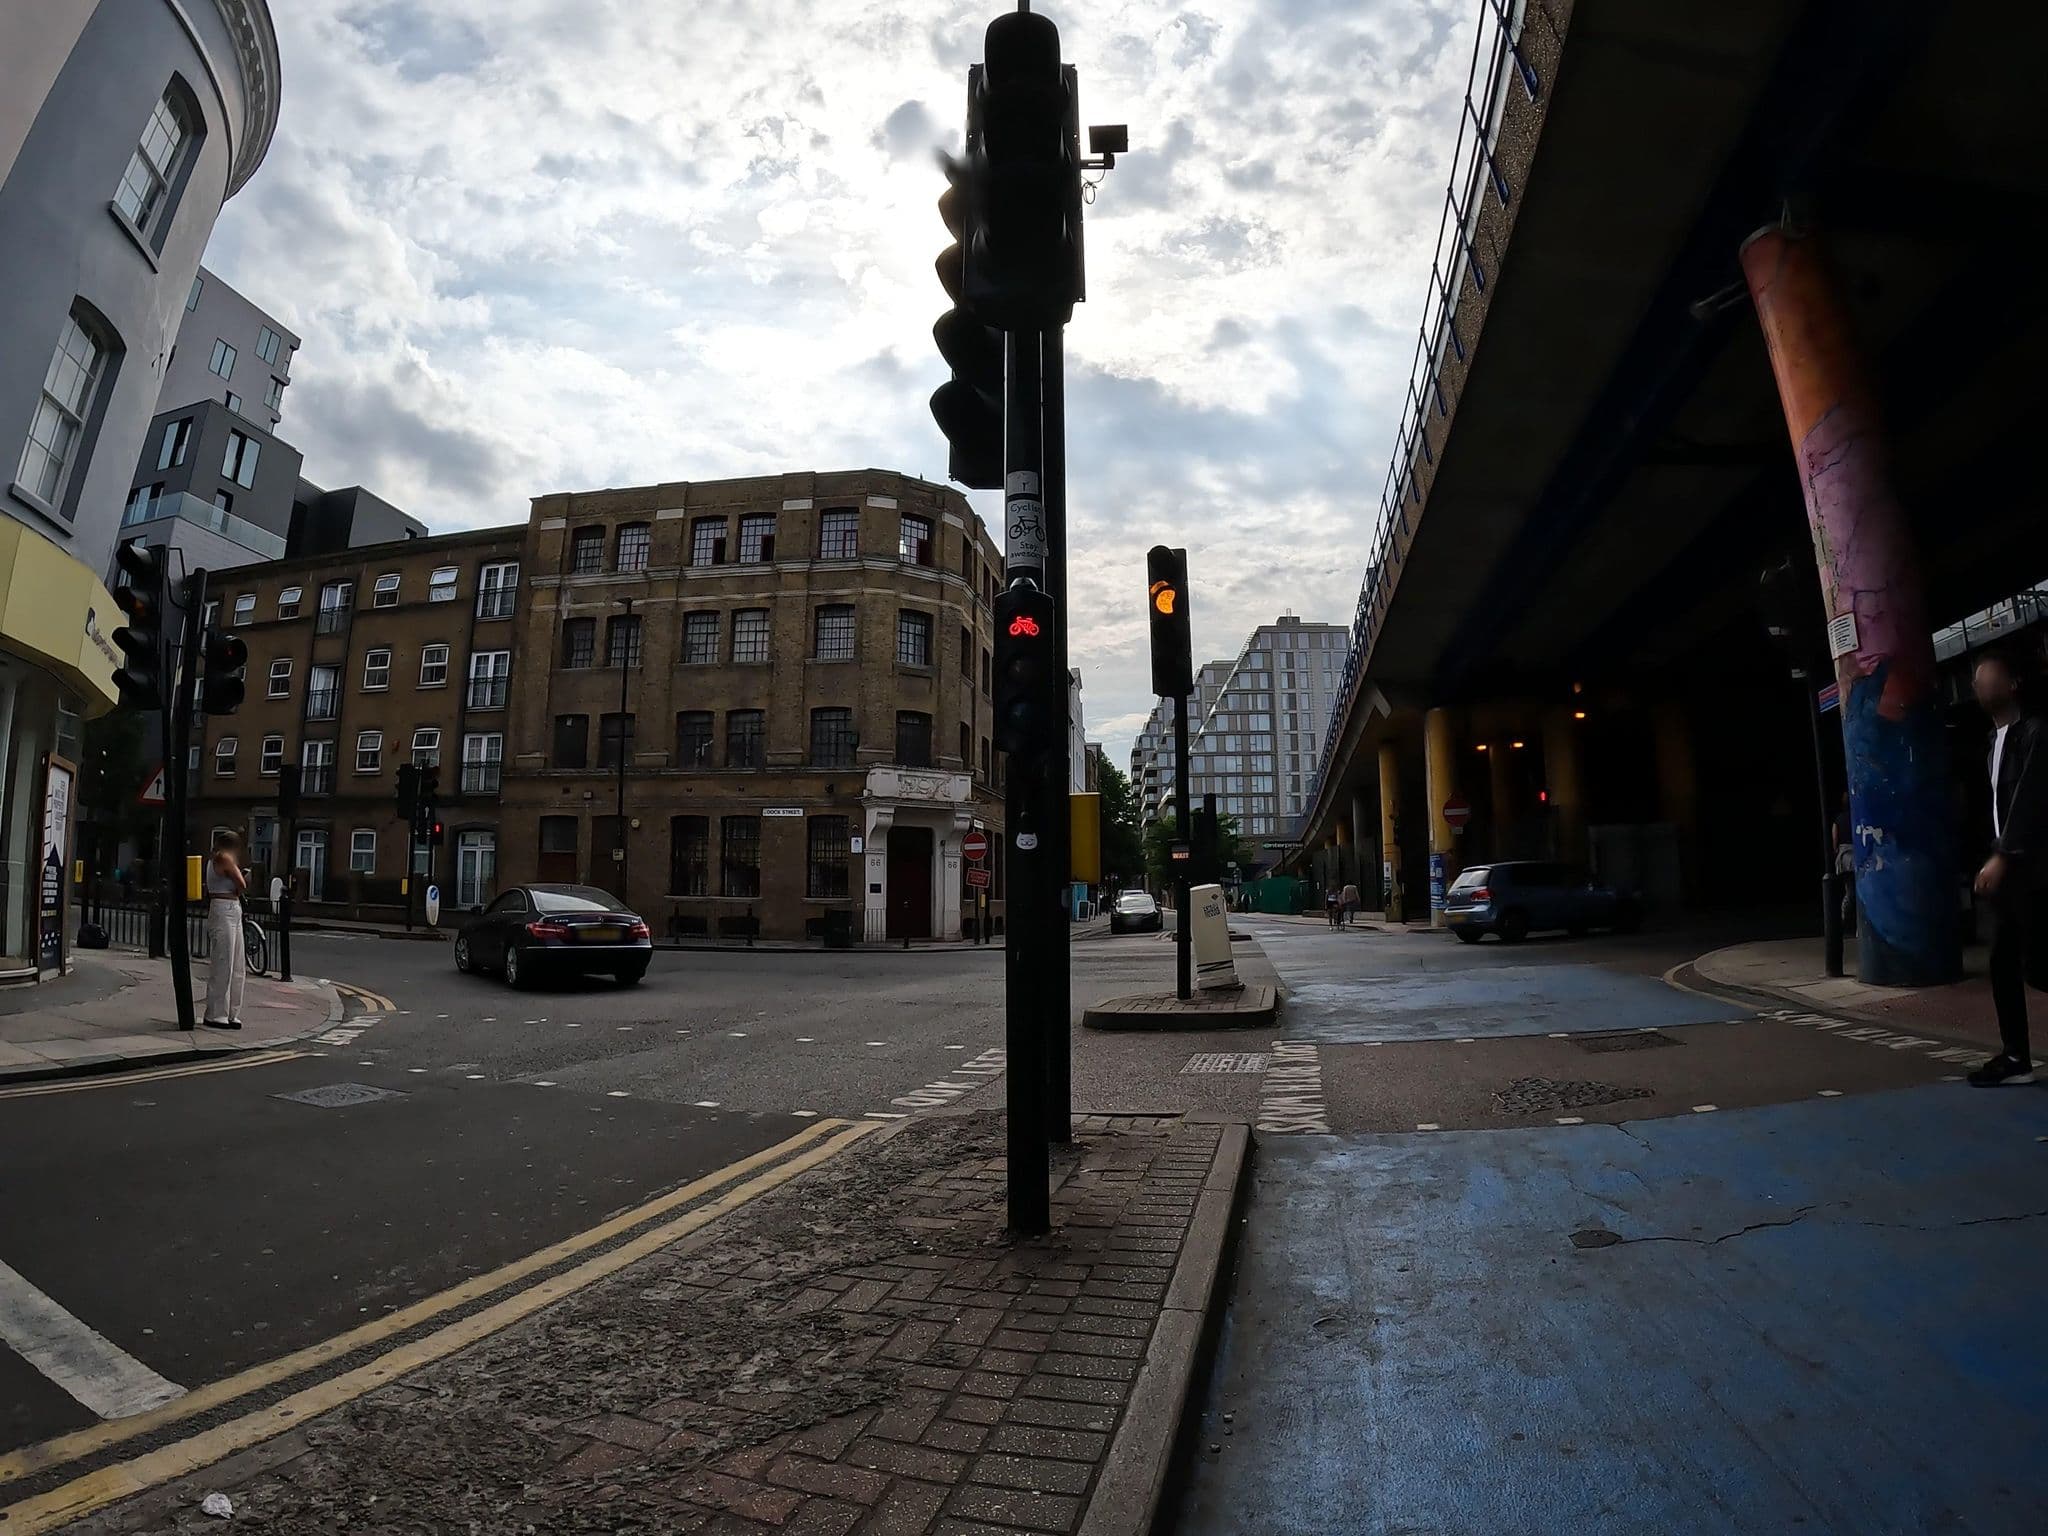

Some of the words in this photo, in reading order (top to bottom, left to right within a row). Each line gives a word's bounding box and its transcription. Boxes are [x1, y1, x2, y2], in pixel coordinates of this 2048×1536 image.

[1020, 541, 1039, 552] Stay
[1266, 1039, 1320, 1064] LOOK
[1260, 1065, 1323, 1093] BOTH
[1255, 1094, 1332, 1134] WAYS
